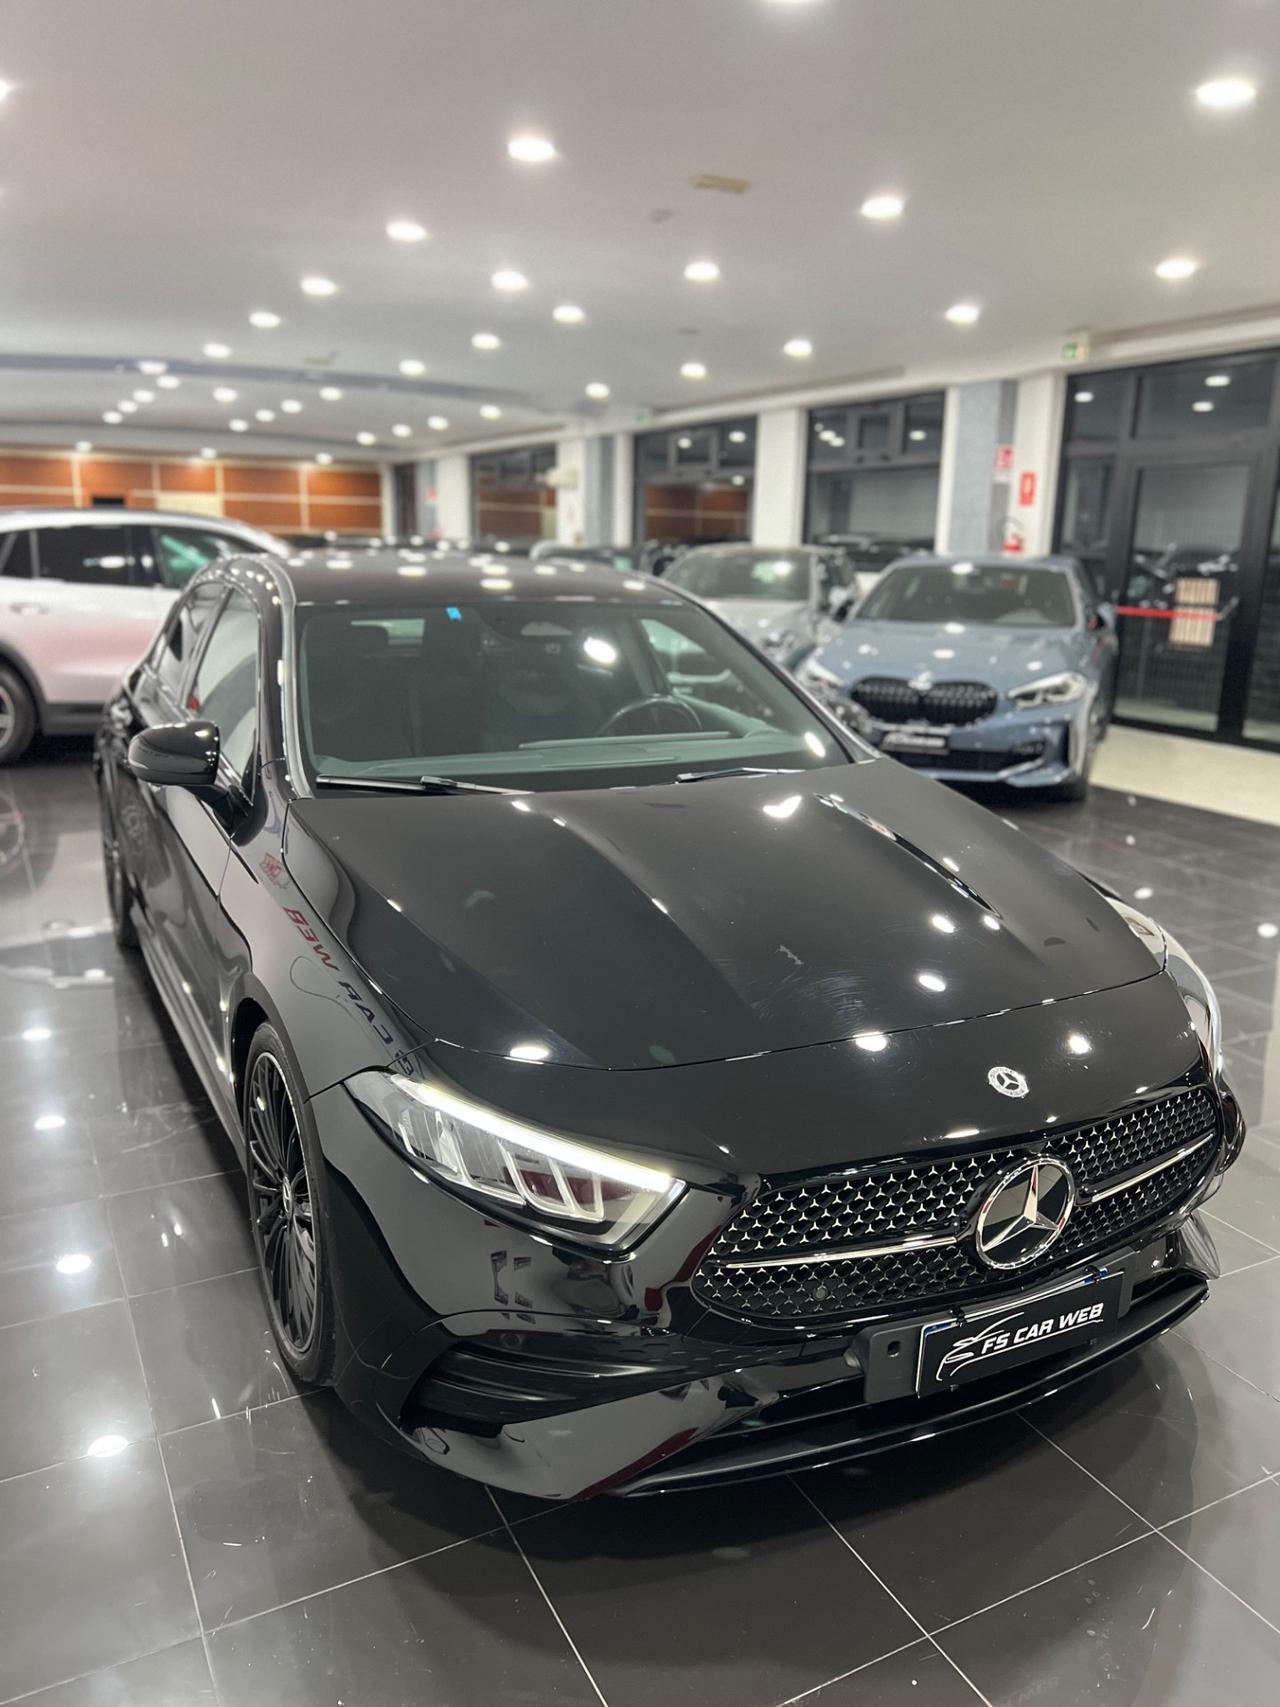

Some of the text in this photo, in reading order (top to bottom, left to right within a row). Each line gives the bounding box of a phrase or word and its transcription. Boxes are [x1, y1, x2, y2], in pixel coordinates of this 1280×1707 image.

[981, 1302, 1104, 1354] FS CAR WEB
